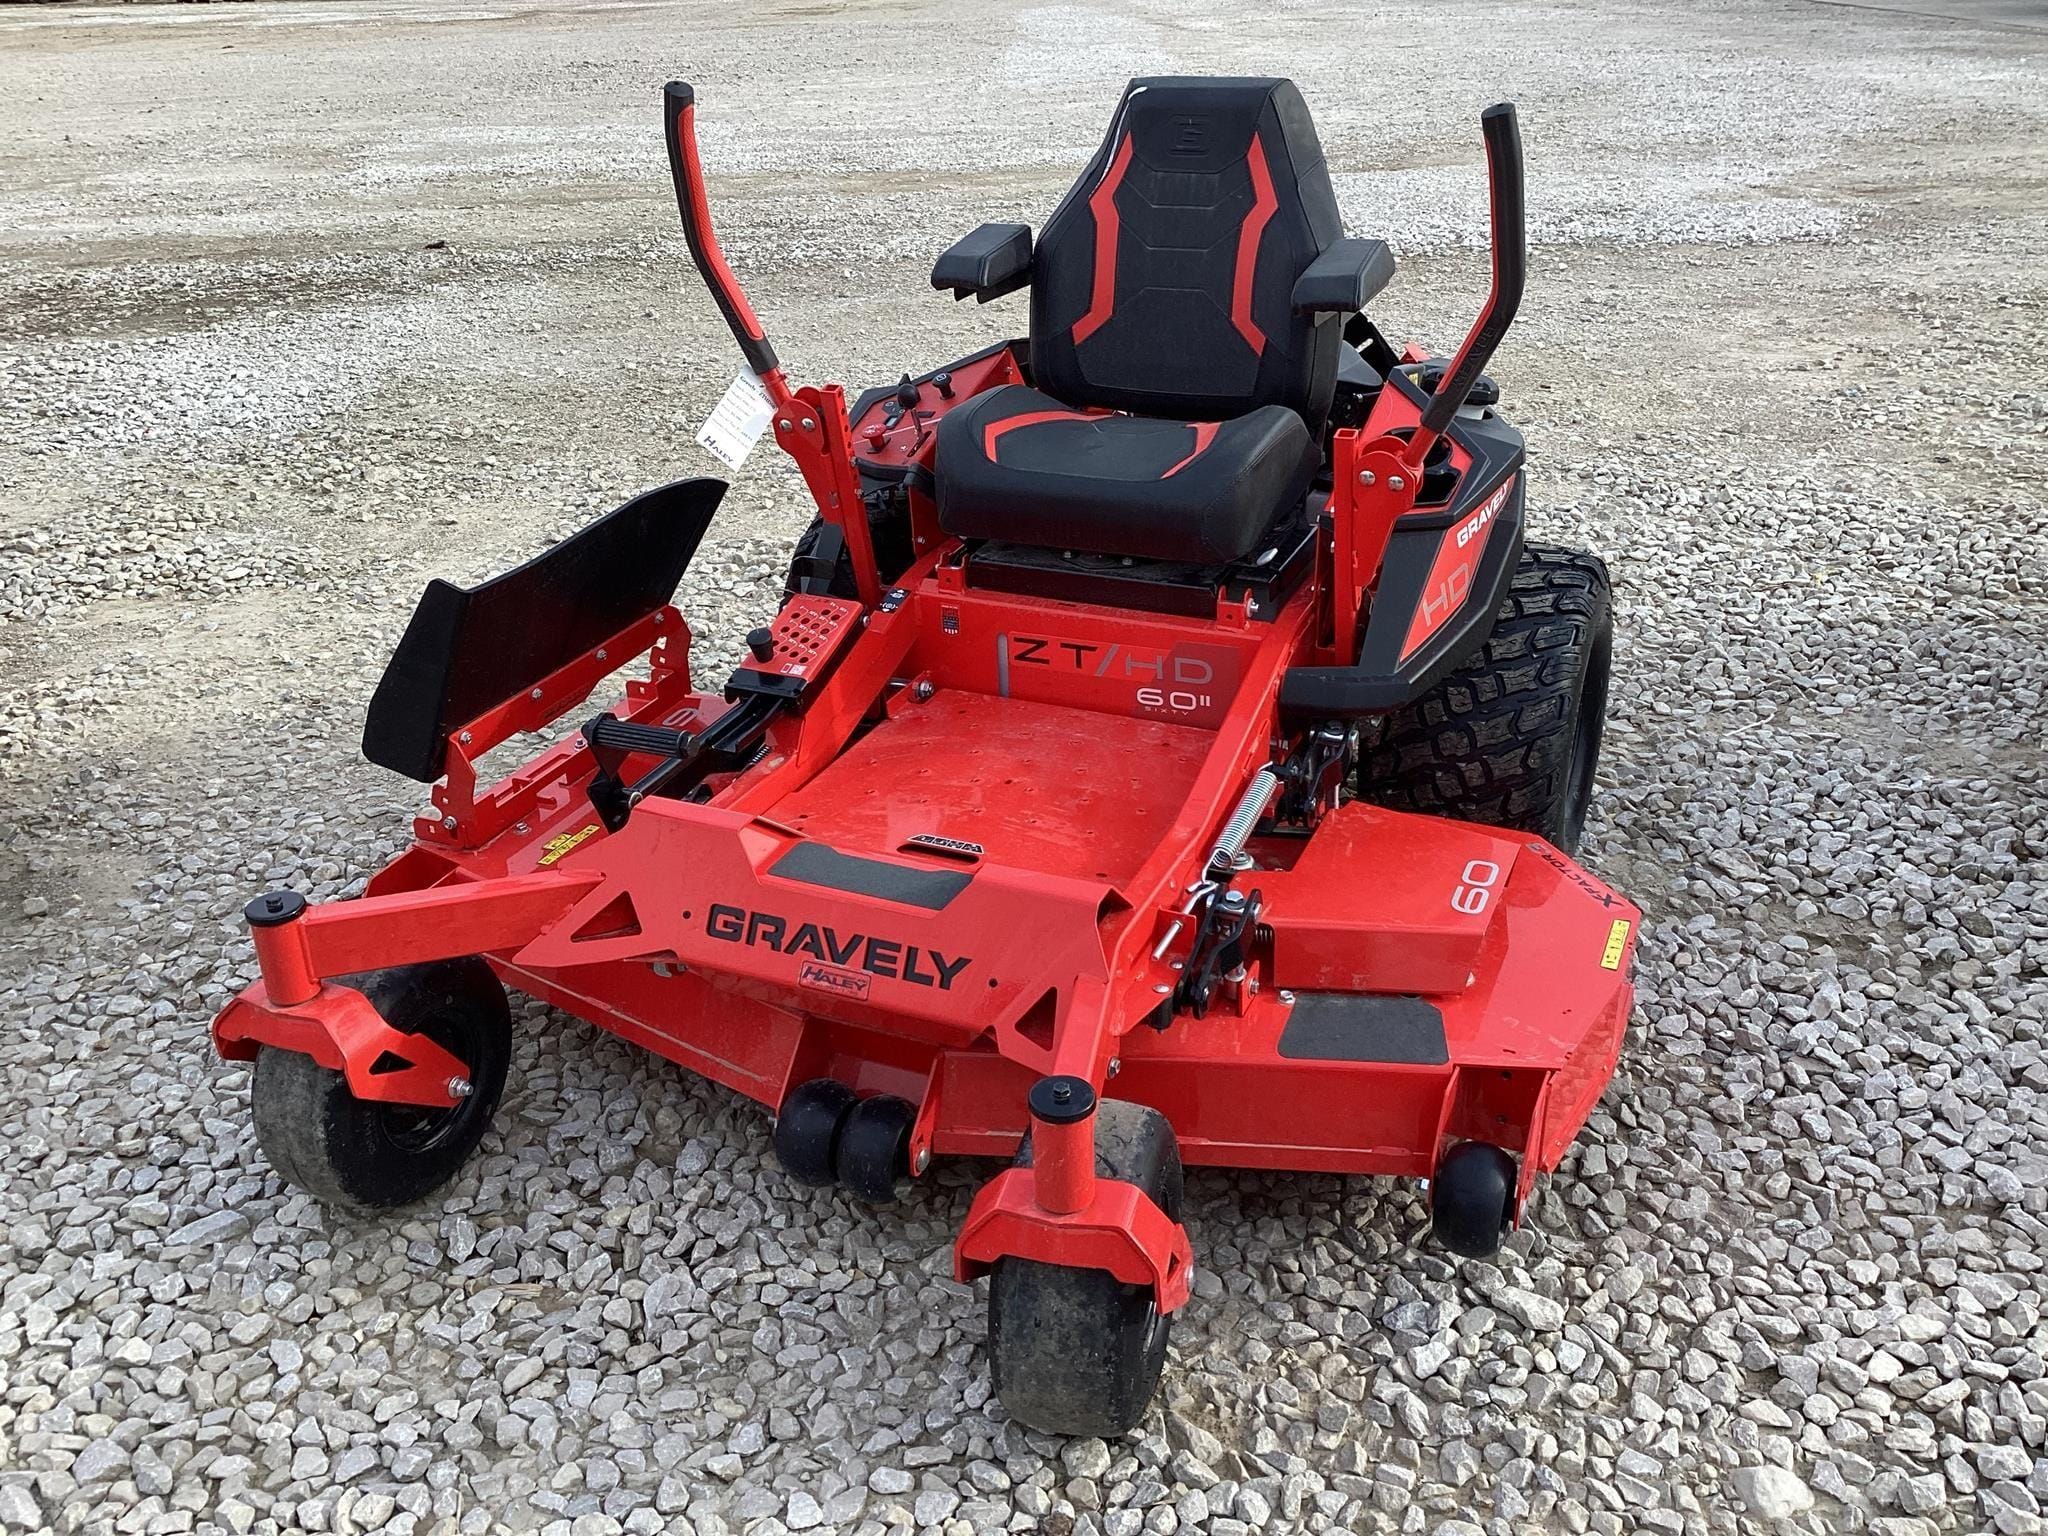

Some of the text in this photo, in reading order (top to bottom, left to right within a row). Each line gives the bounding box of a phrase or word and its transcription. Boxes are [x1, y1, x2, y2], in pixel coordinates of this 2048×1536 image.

[703, 435, 734, 462] HALEY
[1456, 477, 1509, 548] GRAVELY
[1422, 563, 1470, 627] HD
[1143, 706, 1190, 716] SIXTY
[1450, 860, 1500, 914] 60
[706, 903, 972, 990] GRAVELY
[802, 964, 867, 991] HALEY
